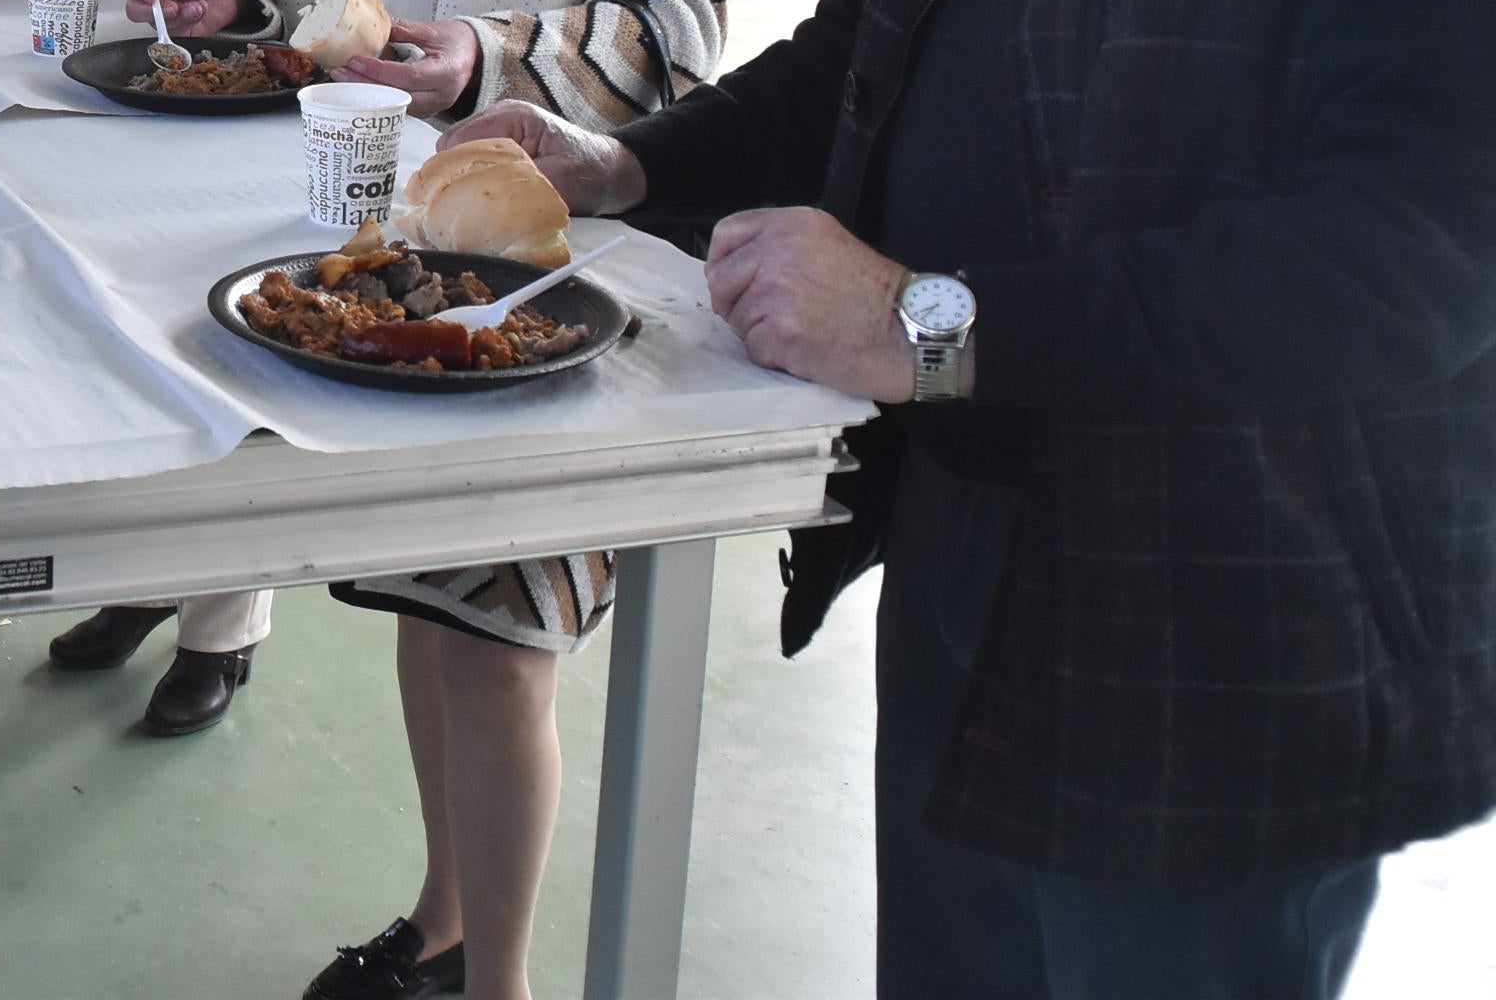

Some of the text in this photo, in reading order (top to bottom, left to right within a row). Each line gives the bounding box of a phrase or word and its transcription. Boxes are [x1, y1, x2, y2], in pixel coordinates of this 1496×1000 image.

[73, 0, 85, 51] appuccino
[312, 128, 354, 142] mocha
[333, 136, 385, 159] coffee
[316, 150, 332, 222] cappuccino
[332, 151, 344, 205] americano
